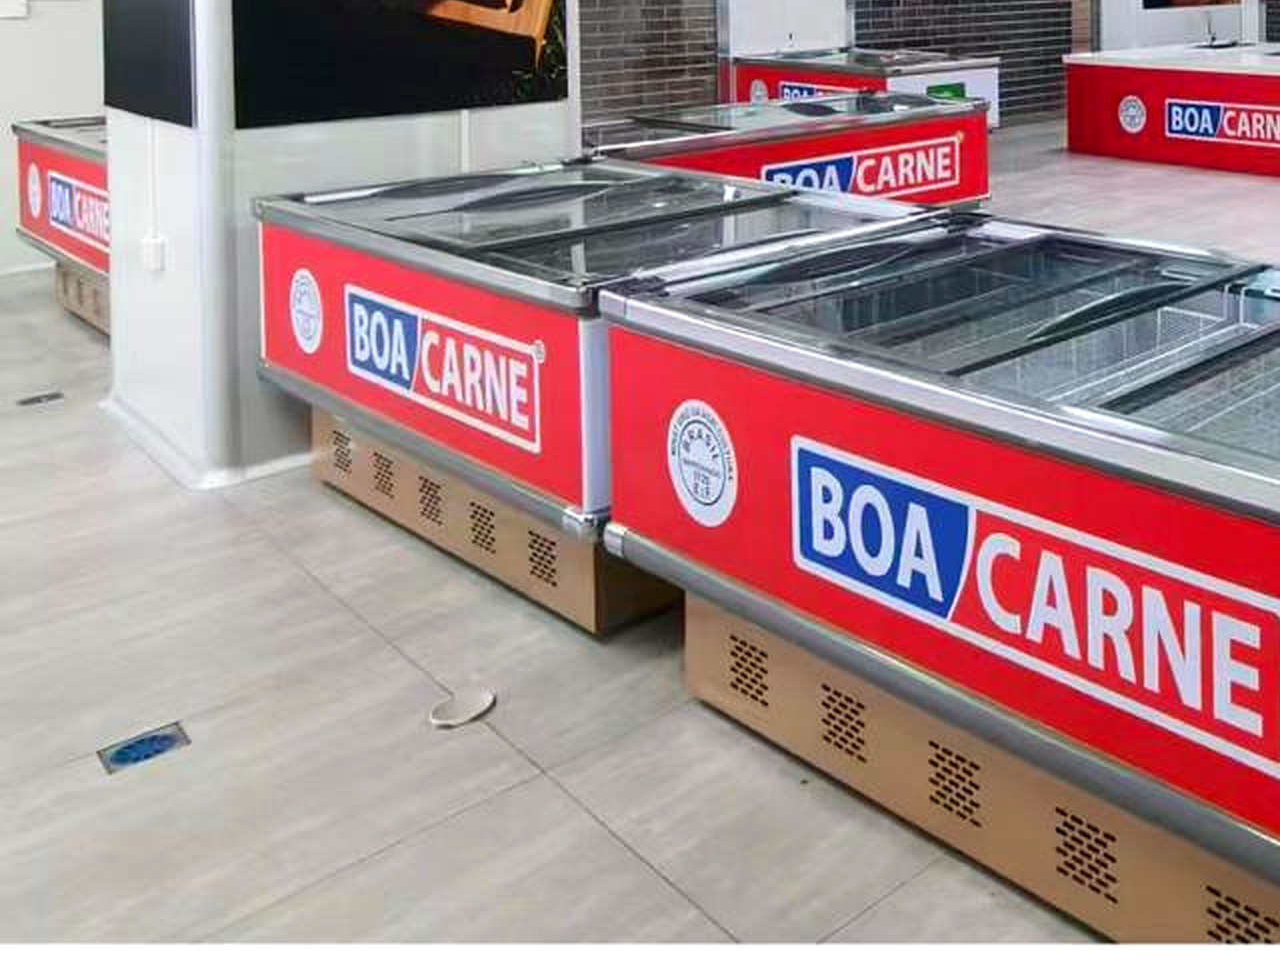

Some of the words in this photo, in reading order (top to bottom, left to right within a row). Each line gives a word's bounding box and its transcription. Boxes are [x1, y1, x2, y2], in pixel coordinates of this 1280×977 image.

[1170, 104, 1216, 135] BOA
[856, 146, 951, 193] CARNE
[352, 302, 411, 381] BOA
[420, 330, 530, 431] CARNE
[808, 465, 946, 602] BOA
[975, 530, 1265, 740] CARNE
